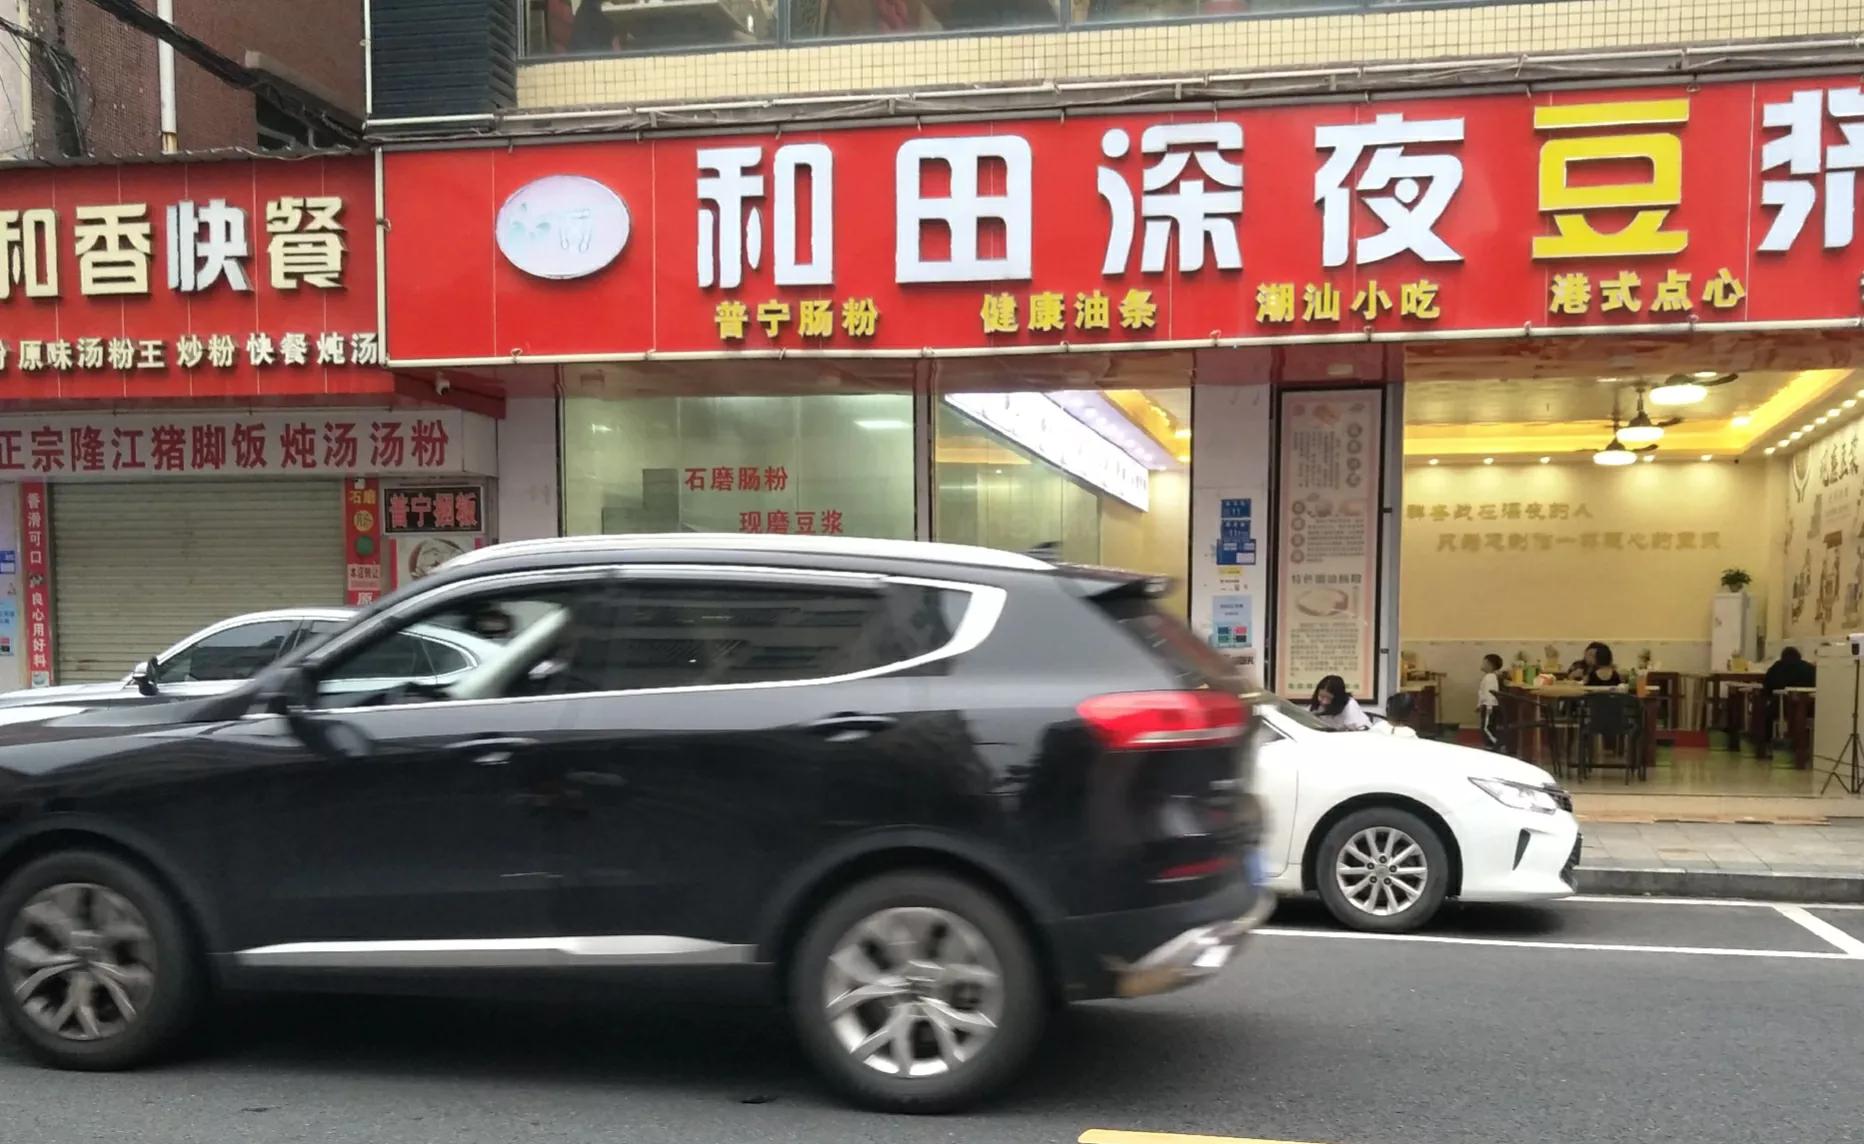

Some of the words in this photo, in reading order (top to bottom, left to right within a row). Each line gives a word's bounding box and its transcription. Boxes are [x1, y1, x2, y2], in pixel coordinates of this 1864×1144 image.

[0, 196, 347, 298] 和香快餐
[714, 297, 879, 340] 普宁肠粉
[980, 289, 1158, 335] 健康油条
[1255, 278, 1441, 323] 潮汕小吃
[1549, 267, 1746, 314] 港式点心
[18, 335, 166, 371] 原味汤粉王
[176, 334, 236, 369] 炒粉
[246, 332, 310, 366] 快餐
[315, 331, 379, 365] 炖汤
[0, 420, 267, 473] 正宗隆江猪脚饭
[280, 420, 359, 468] 炖汤
[369, 419, 450, 467] 汤粉
[684, 465, 789, 492] 石磨肠粉
[738, 510, 844, 534] 现磨豆浆
